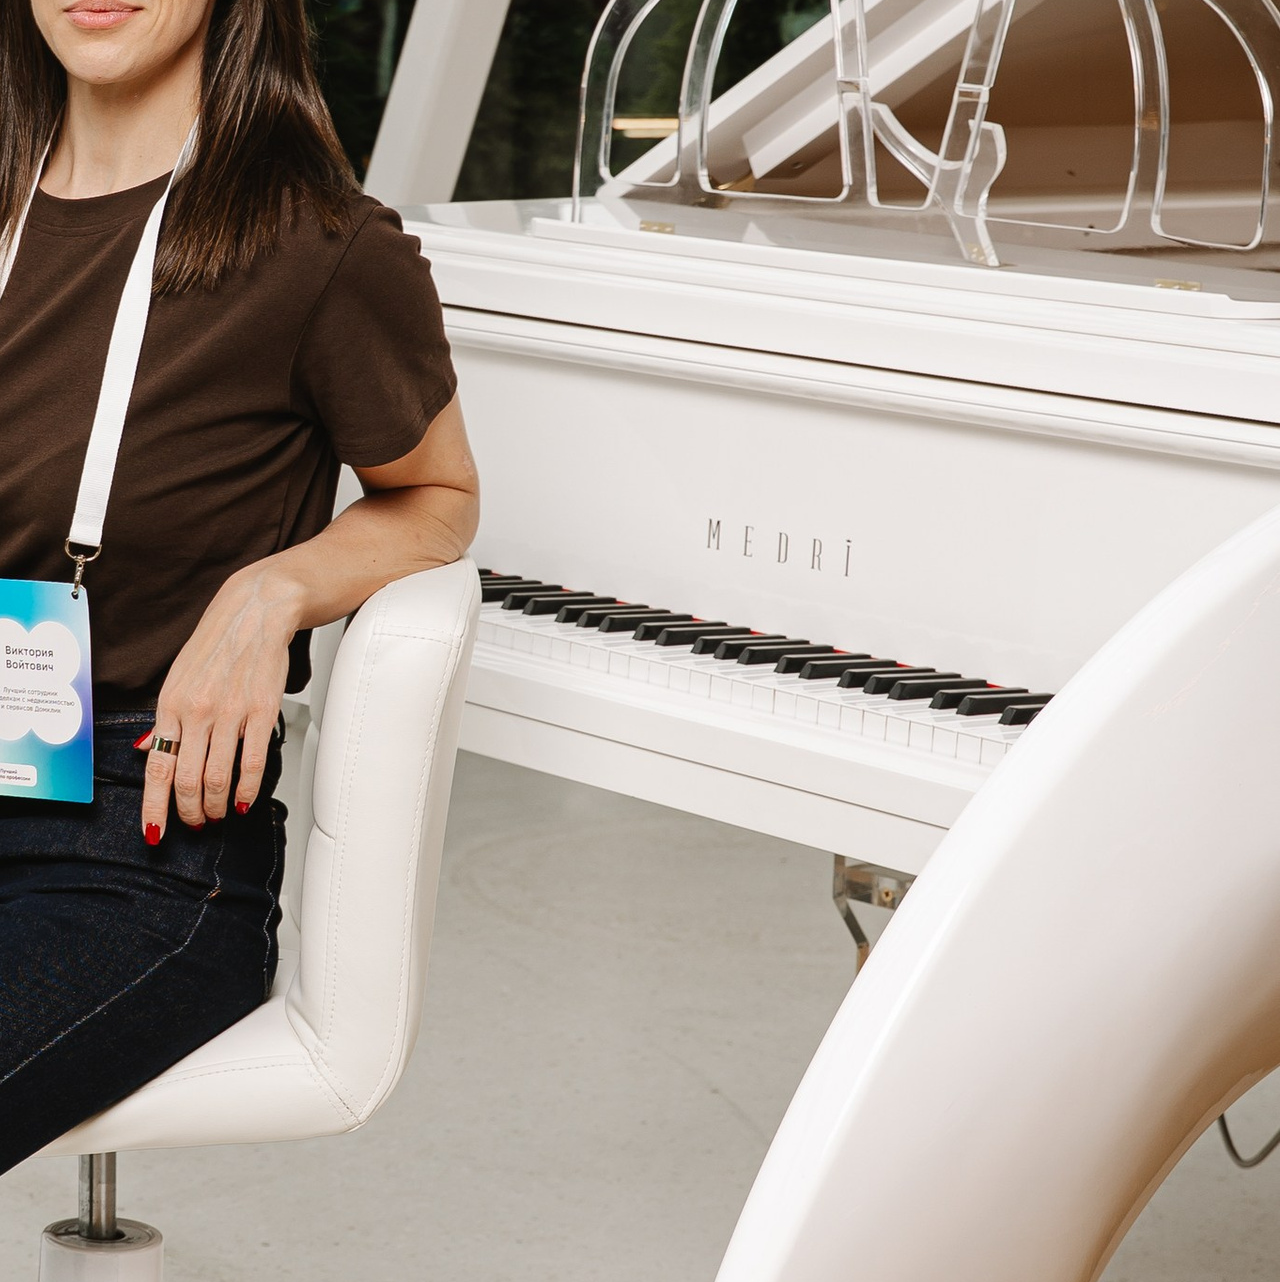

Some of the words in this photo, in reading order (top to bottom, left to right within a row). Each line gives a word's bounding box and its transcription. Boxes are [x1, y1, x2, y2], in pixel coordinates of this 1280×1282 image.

[5, 645, 54, 658] Виктория
[6, 659, 54, 671] Войтович
[3, 686, 27, 695] Лучший
[27, 689, 58, 697] сотрудник
[6, 704, 34, 712] сервисов
[27, 698, 75, 707] недвижимостью
